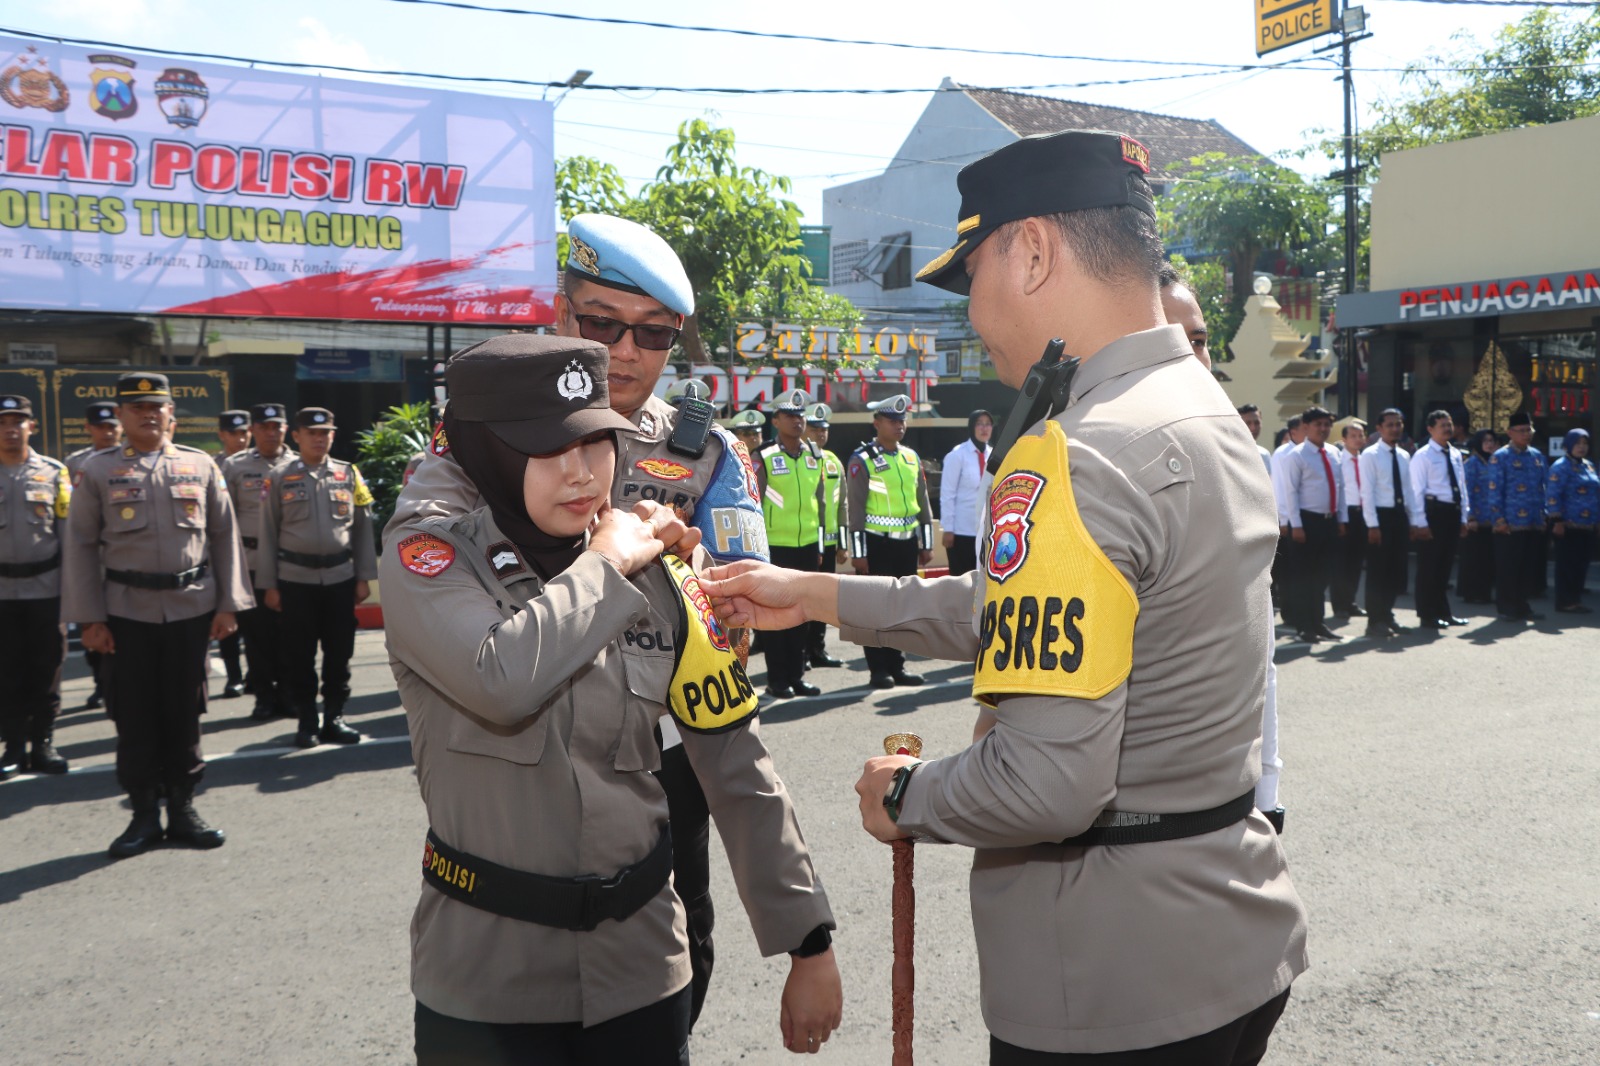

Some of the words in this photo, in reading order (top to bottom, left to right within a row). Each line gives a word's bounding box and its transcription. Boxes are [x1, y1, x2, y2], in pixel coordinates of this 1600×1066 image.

[1261, 8, 1323, 45] POLICE
[0, 123, 137, 187] LAR
[149, 138, 355, 202] POLISI
[364, 157, 467, 210] RW
[134, 199, 403, 250] TULUNGAGUNG
[21, 244, 135, 270] Tulungagung
[254, 257, 287, 273] Dan
[455, 300, 468, 314] 17
[470, 301, 497, 315] Mei
[499, 302, 533, 317] 2023
[1400, 272, 1600, 319] PENJAGAAN
[75, 385, 117, 399] CATU
[174, 386, 209, 398] ETYA
[624, 630, 676, 652] POL
[430, 851, 476, 893] POLISI
